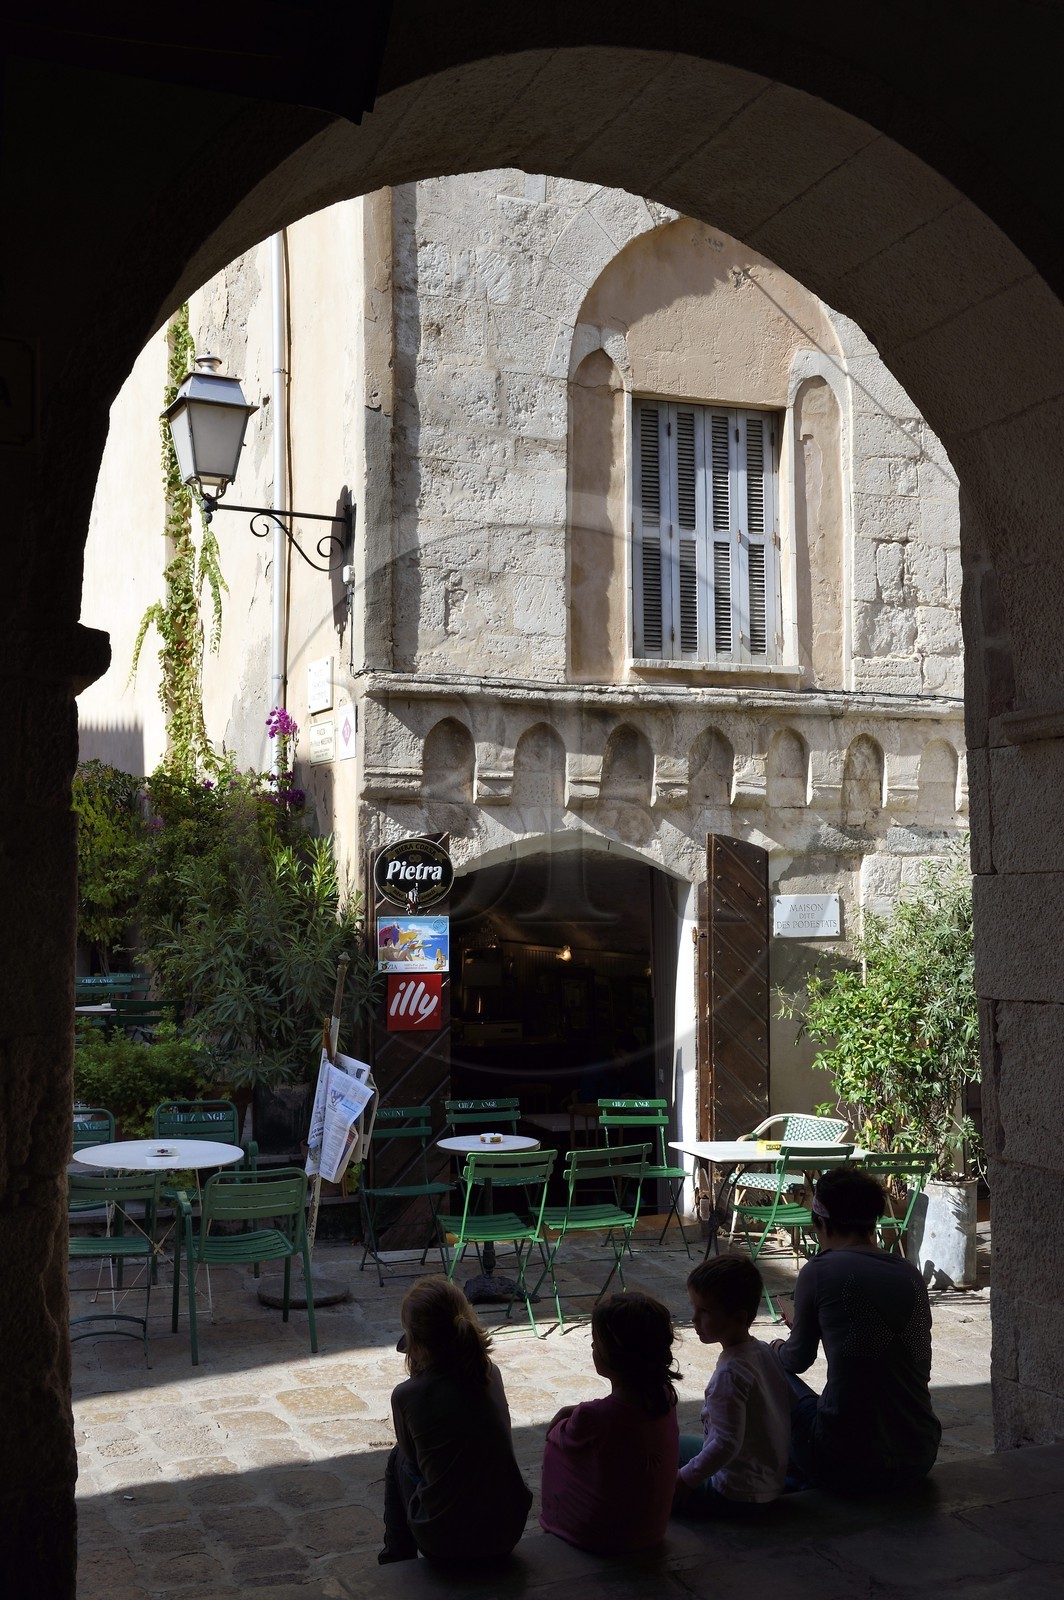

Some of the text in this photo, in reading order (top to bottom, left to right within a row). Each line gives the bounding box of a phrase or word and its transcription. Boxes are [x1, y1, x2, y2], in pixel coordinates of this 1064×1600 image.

[395, 843, 436, 856] BIERA CORSA
[385, 860, 443, 880] Pietra
[776, 920, 838, 929] DES PODESTATS
[389, 980, 438, 1025] illy
[199, 1112, 226, 1121] ANGE
